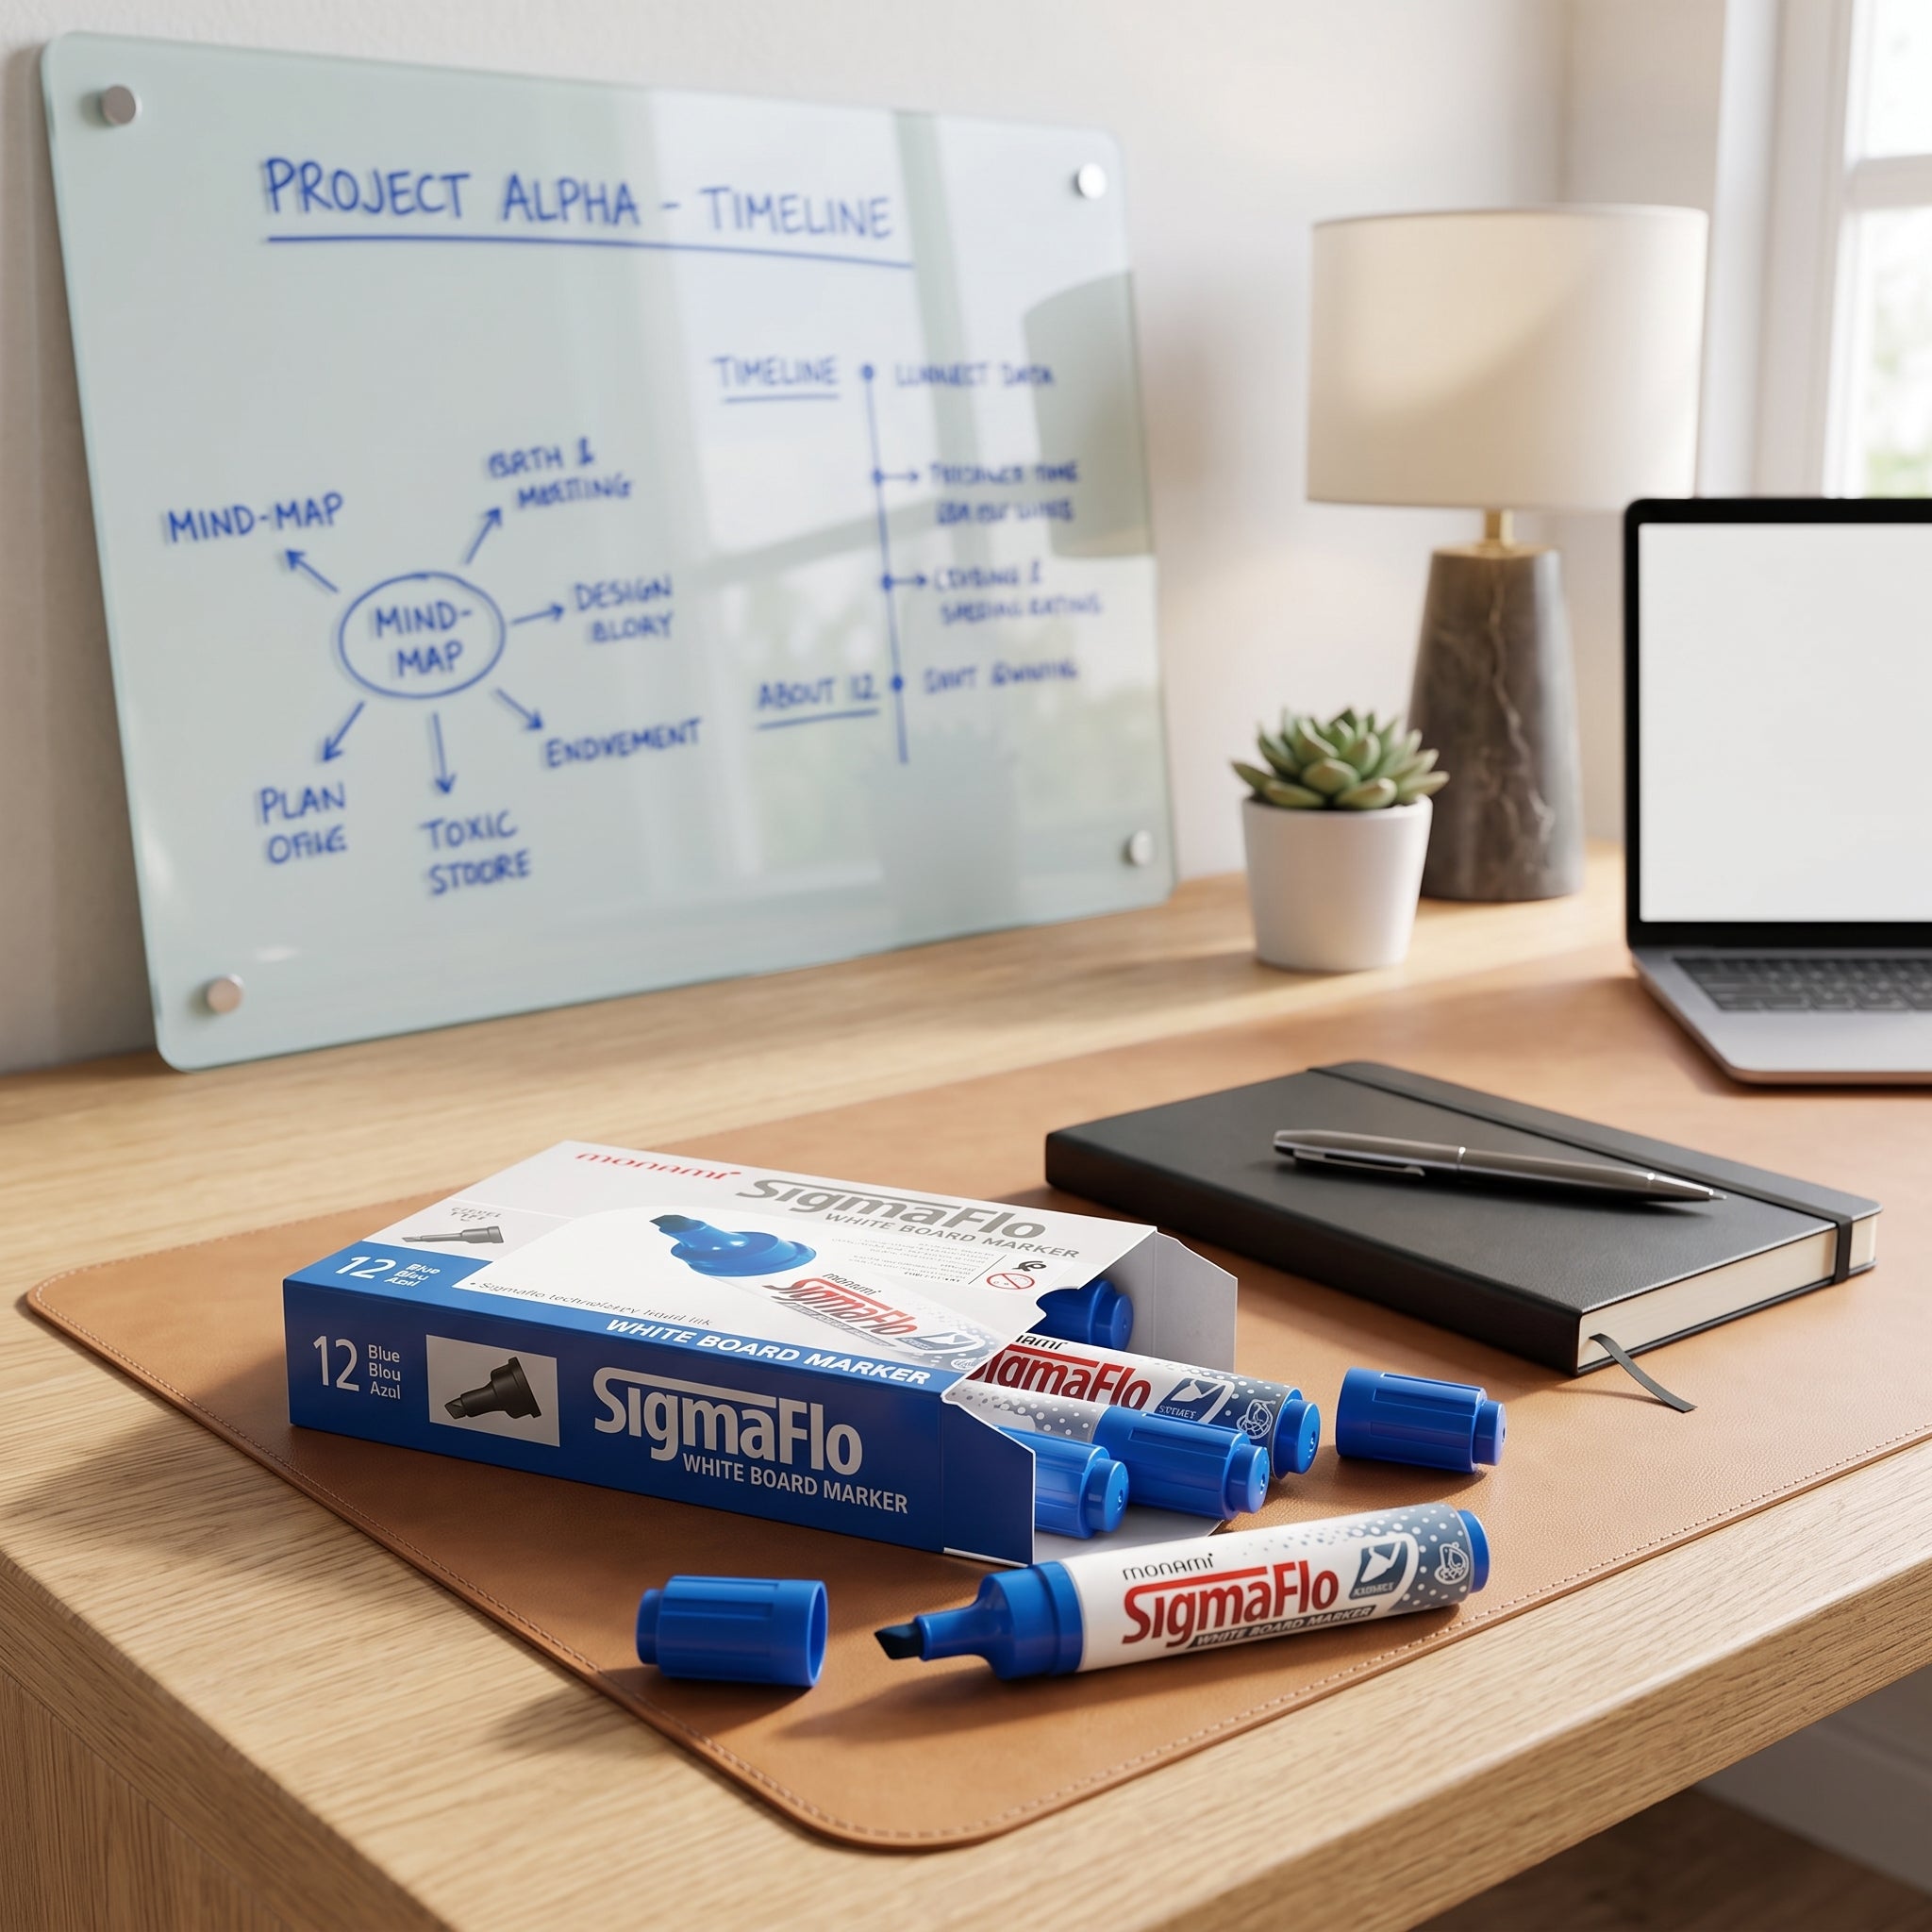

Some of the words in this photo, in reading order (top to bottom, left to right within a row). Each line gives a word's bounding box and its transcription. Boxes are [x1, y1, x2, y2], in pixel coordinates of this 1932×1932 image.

[263, 157, 471, 218] PROJECT
[500, 171, 641, 226] ALPHA
[701, 185, 892, 241] TIMELINE
[713, 355, 840, 388] TIMELINE
[165, 491, 343, 543] MIND-MAP
[574, 573, 673, 612] DESIGN
[395, 639, 464, 678] MAP
[757, 677, 836, 711] ABOUT
[259, 782, 346, 825] PLAN
[421, 809, 519, 851] TOXIC
[735, 1179, 1047, 1240] SigmaFlo
[824, 1213, 893, 1231] WHITE
[899, 1224, 976, 1243] BOARD
[980, 1239, 1081, 1259] MARKER
[335, 1256, 397, 1279] 12
[313, 1335, 359, 1391] 12
[368, 1343, 401, 1363] Blue
[369, 1361, 401, 1382] Blou
[606, 1319, 696, 1344] WHITE
[695, 1335, 801, 1362] BOARD
[804, 1353, 932, 1386] MARKER
[592, 1366, 863, 1476] SigmaFlo
[682, 1452, 744, 1483] WHITE
[750, 1466, 818, 1496] BOARD
[824, 1478, 908, 1514] MARKER
[1123, 1553, 1214, 1581] monami
[1121, 1559, 1340, 1649] SigmaFlo
[1195, 1628, 1247, 1646] WHITE
[1249, 1619, 1304, 1637] BOARD
[1306, 1607, 1372, 1627] MARKER
